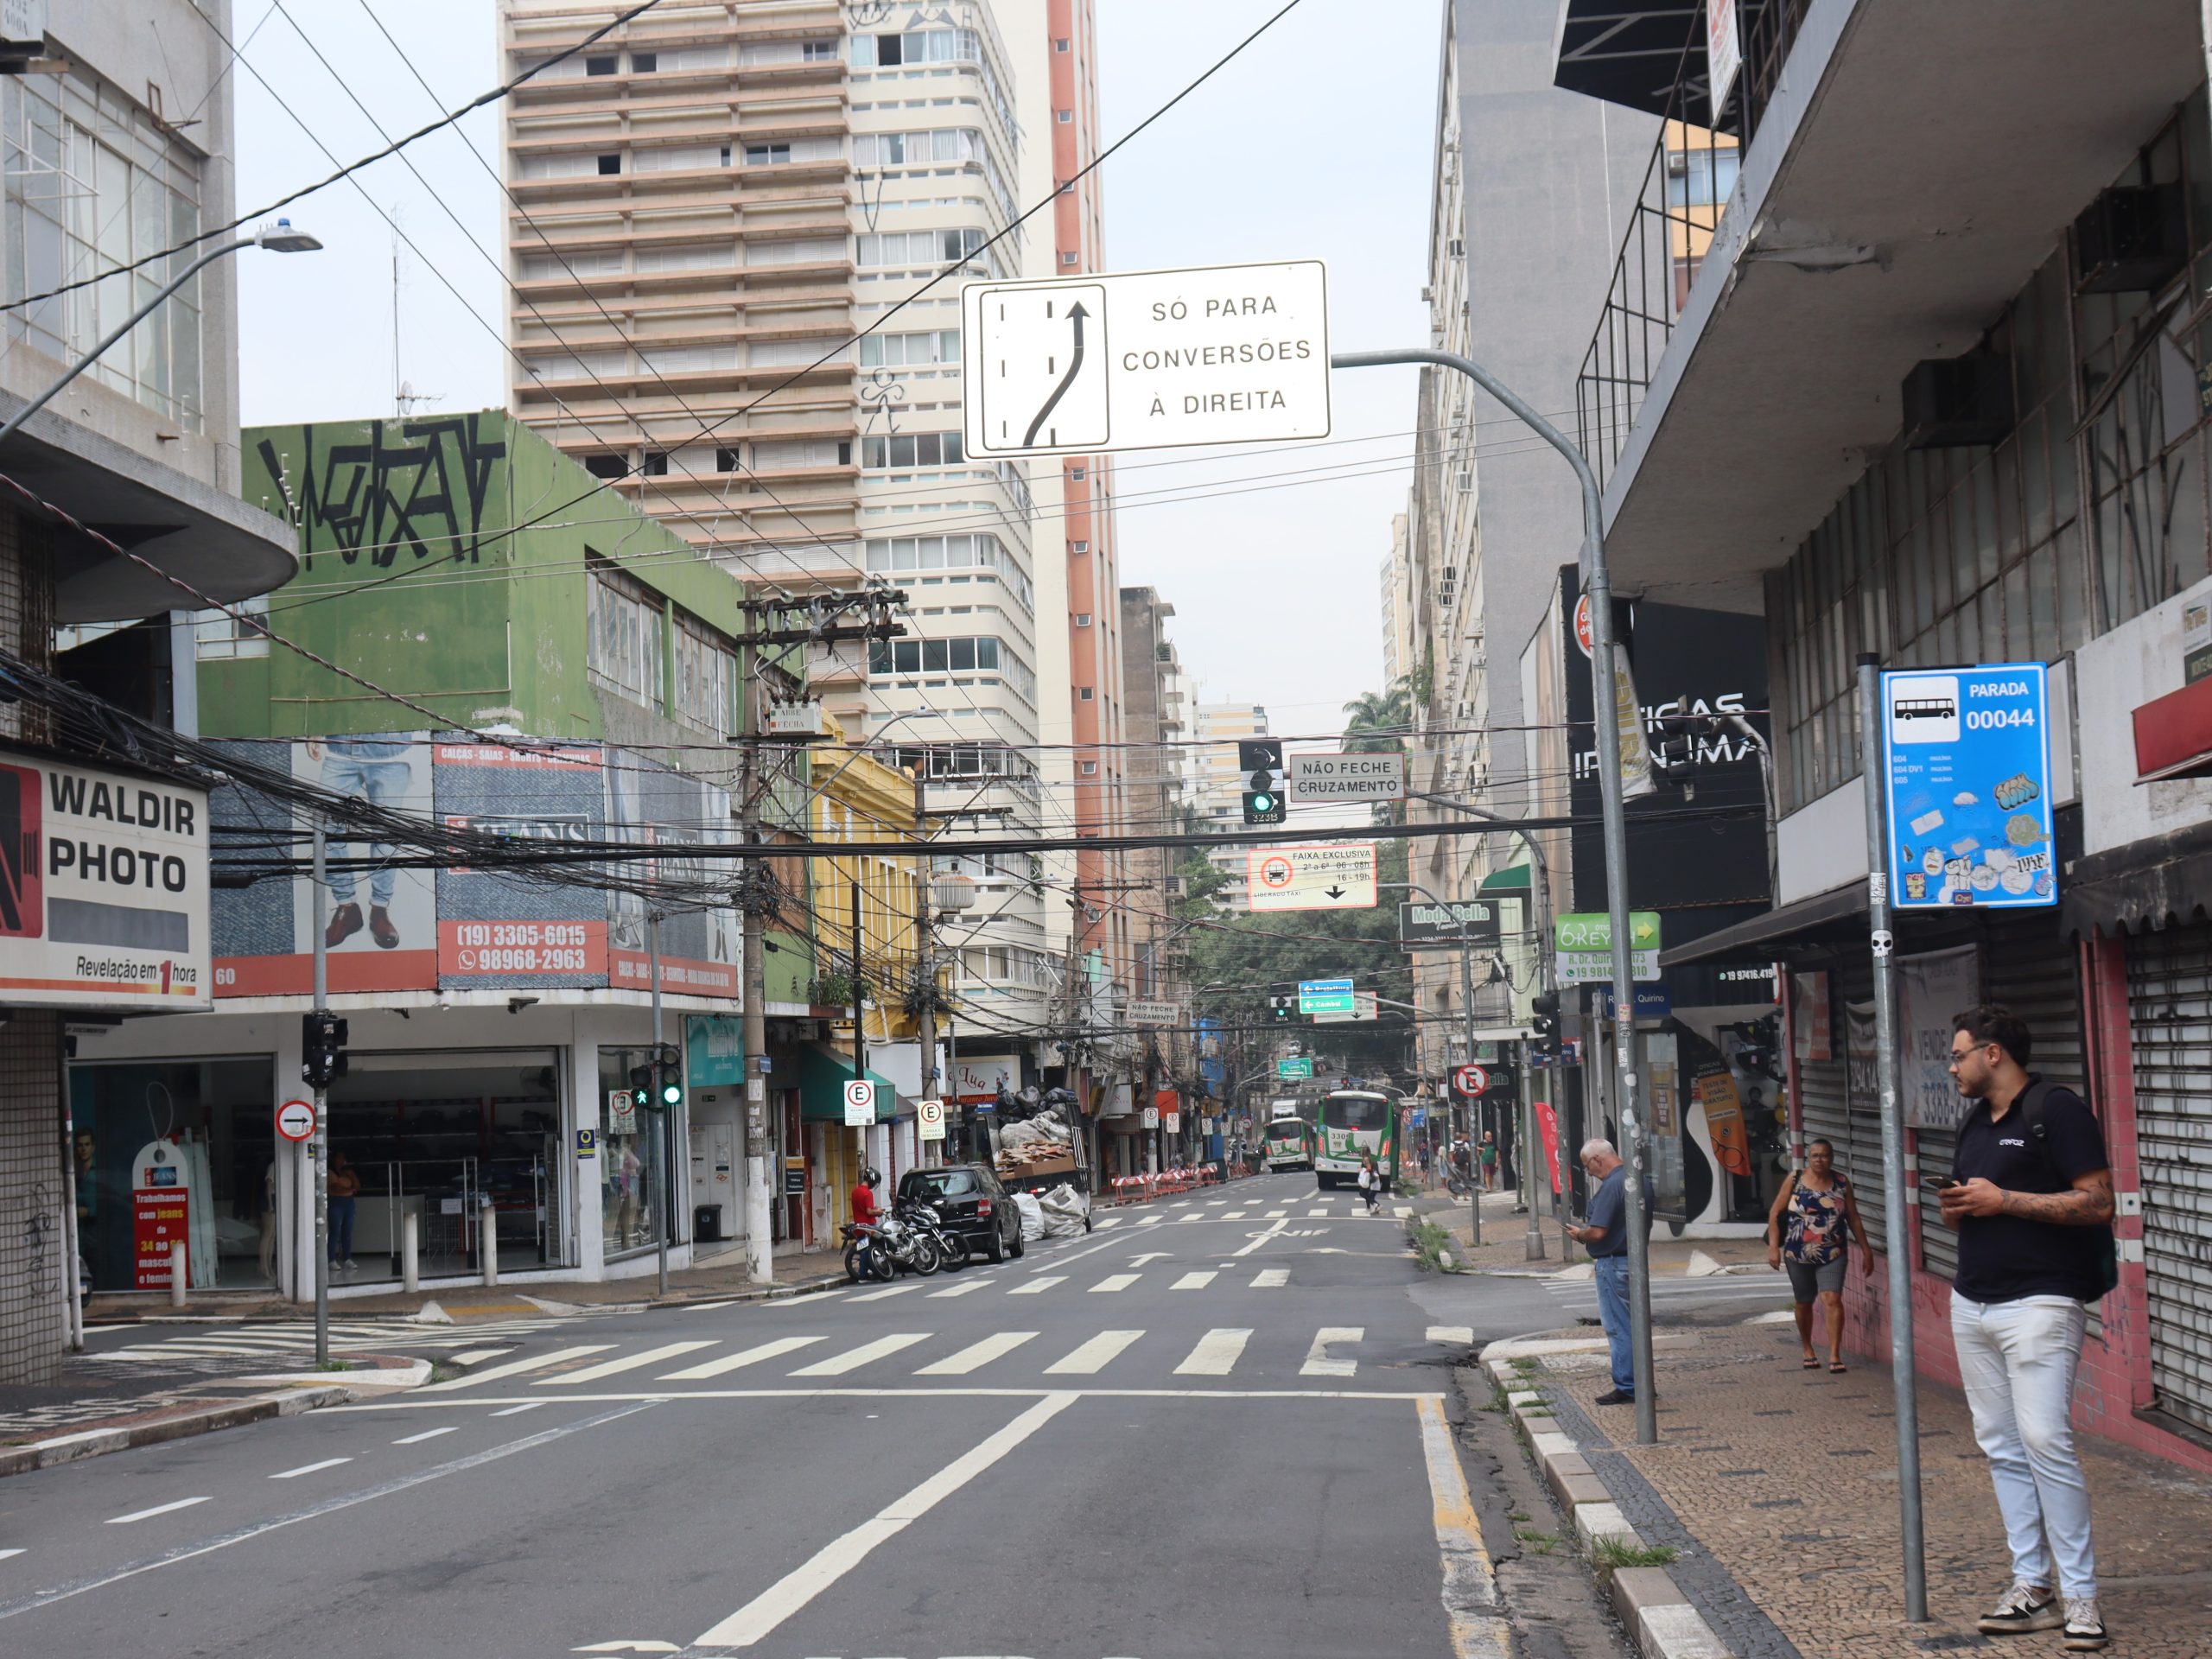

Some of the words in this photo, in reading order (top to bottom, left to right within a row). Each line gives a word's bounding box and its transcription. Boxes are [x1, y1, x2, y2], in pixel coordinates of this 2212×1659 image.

[1152, 296, 1189, 321] SÓ
[1206, 296, 1277, 318] PARA
[1122, 338, 1311, 372] CONVERSÕES
[1150, 391, 1165, 416] À
[1184, 390, 1287, 415] DIREITA
[1969, 682, 2029, 698] PARADA
[1966, 709, 2035, 730] 00044
[441, 747, 473, 761] CALÇAS
[479, 750, 504, 761] SAIAS
[1575, 734, 1759, 779] IPNMA
[1302, 761, 1334, 774] NÃO
[1341, 762, 1391, 773] FECHE
[1298, 780, 1397, 793] CRUZAMENTO
[49, 772, 194, 836] WALDIR
[1323, 850, 1370, 859] EXCLUSIVA
[49, 836, 186, 893] PHOTO
[1412, 906, 1451, 924] Moda
[1452, 904, 1491, 922] Bella
[457, 925, 490, 946] (19)
[493, 925, 586, 946] 3305-6015
[479, 949, 586, 970] 98968-2963
[1580, 954, 1590, 964] Dr.
[76, 956, 137, 983] Revelação
[140, 962, 156, 979] em
[159, 959, 172, 995] 1
[172, 963, 196, 982] hora
[215, 968, 235, 985] 60
[1727, 971, 1736, 981] 19
[1637, 994, 1664, 1002] Quirino
[959, 1067, 986, 1090] Lua
[855, 1087, 863, 1100] E
[927, 1107, 934, 1118] E
[136, 1194, 186, 1204] Trabalhamos
[157, 1209, 183, 1220] jeans
[140, 1240, 154, 1252] 34
[156, 1241, 168, 1251] ao
[138, 1256, 172, 1268] mascul
[139, 1275, 145, 1284] e
[146, 1274, 172, 1283] femin
